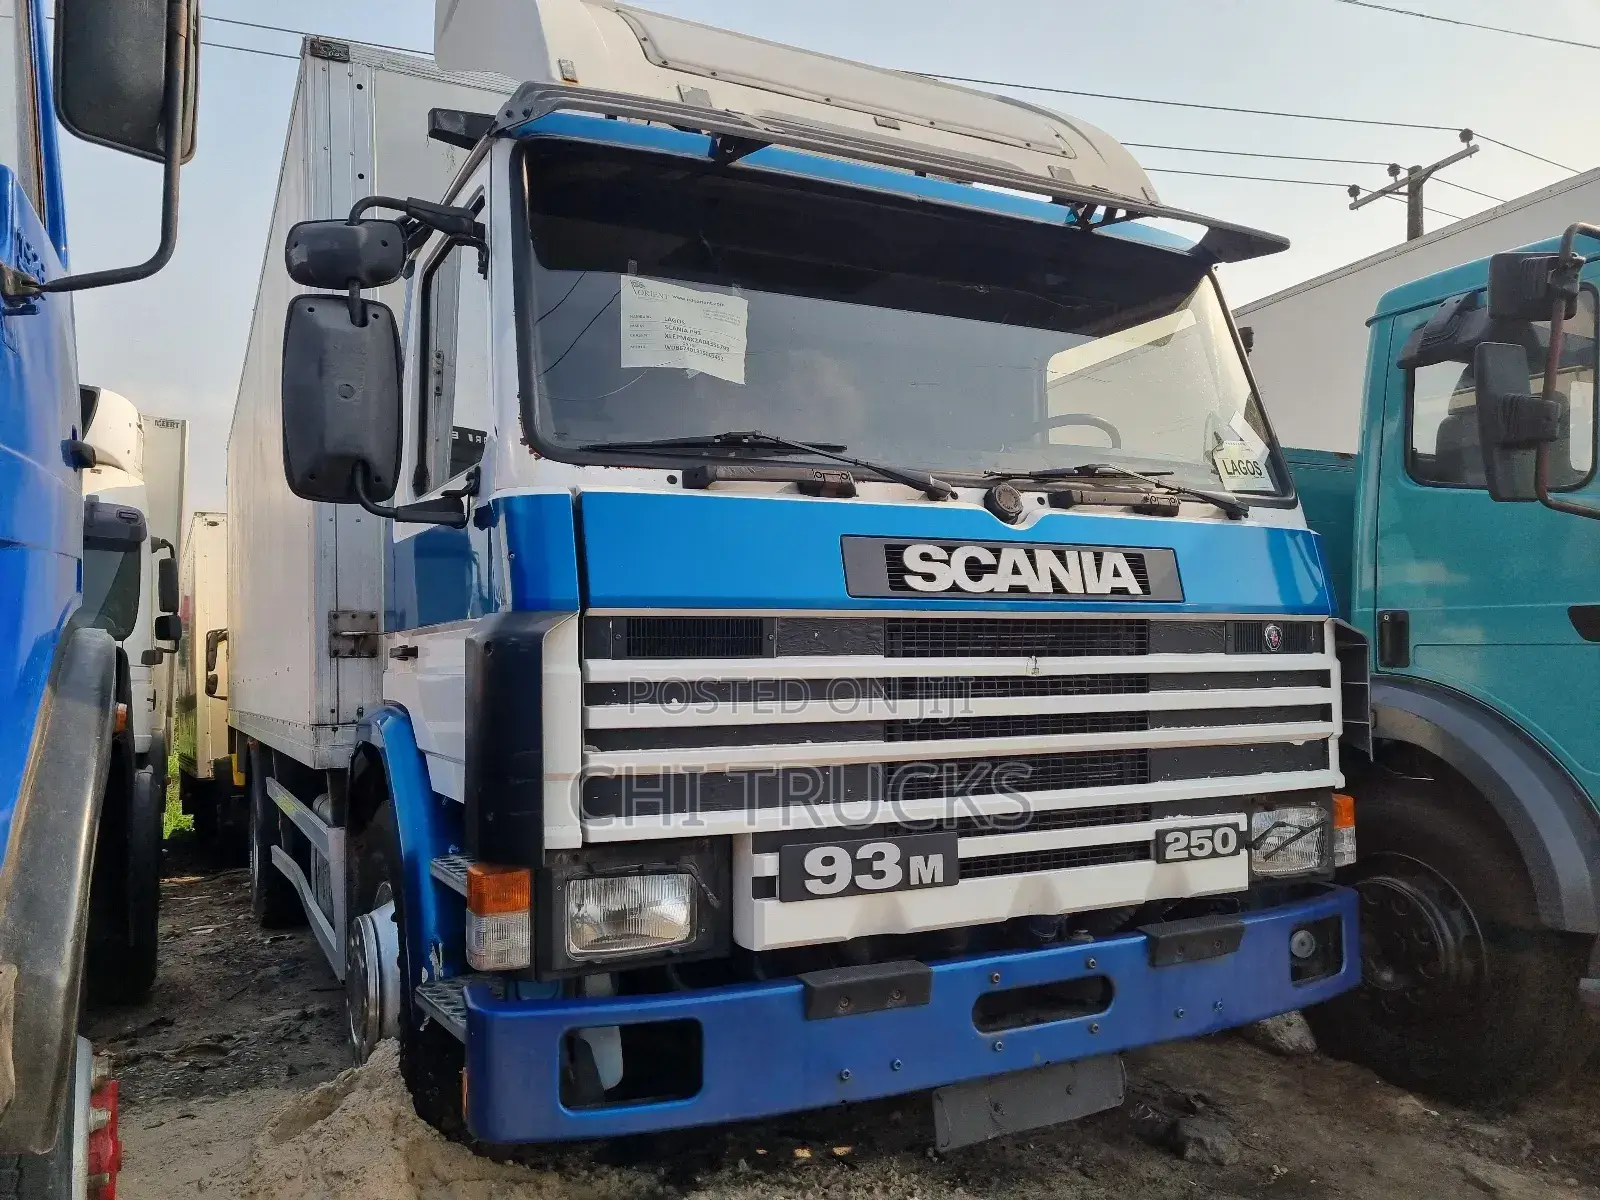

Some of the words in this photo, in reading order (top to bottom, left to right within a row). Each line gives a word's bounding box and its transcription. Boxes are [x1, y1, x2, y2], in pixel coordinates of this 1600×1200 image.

[664, 316, 686, 326] LAGOS
[664, 324, 688, 334] SCANIA
[1222, 459, 1263, 477] LAGOS
[902, 543, 1143, 595] SCANIA
[1165, 826, 1237, 860] 250
[804, 841, 903, 895] 93
[909, 853, 944, 886] M
